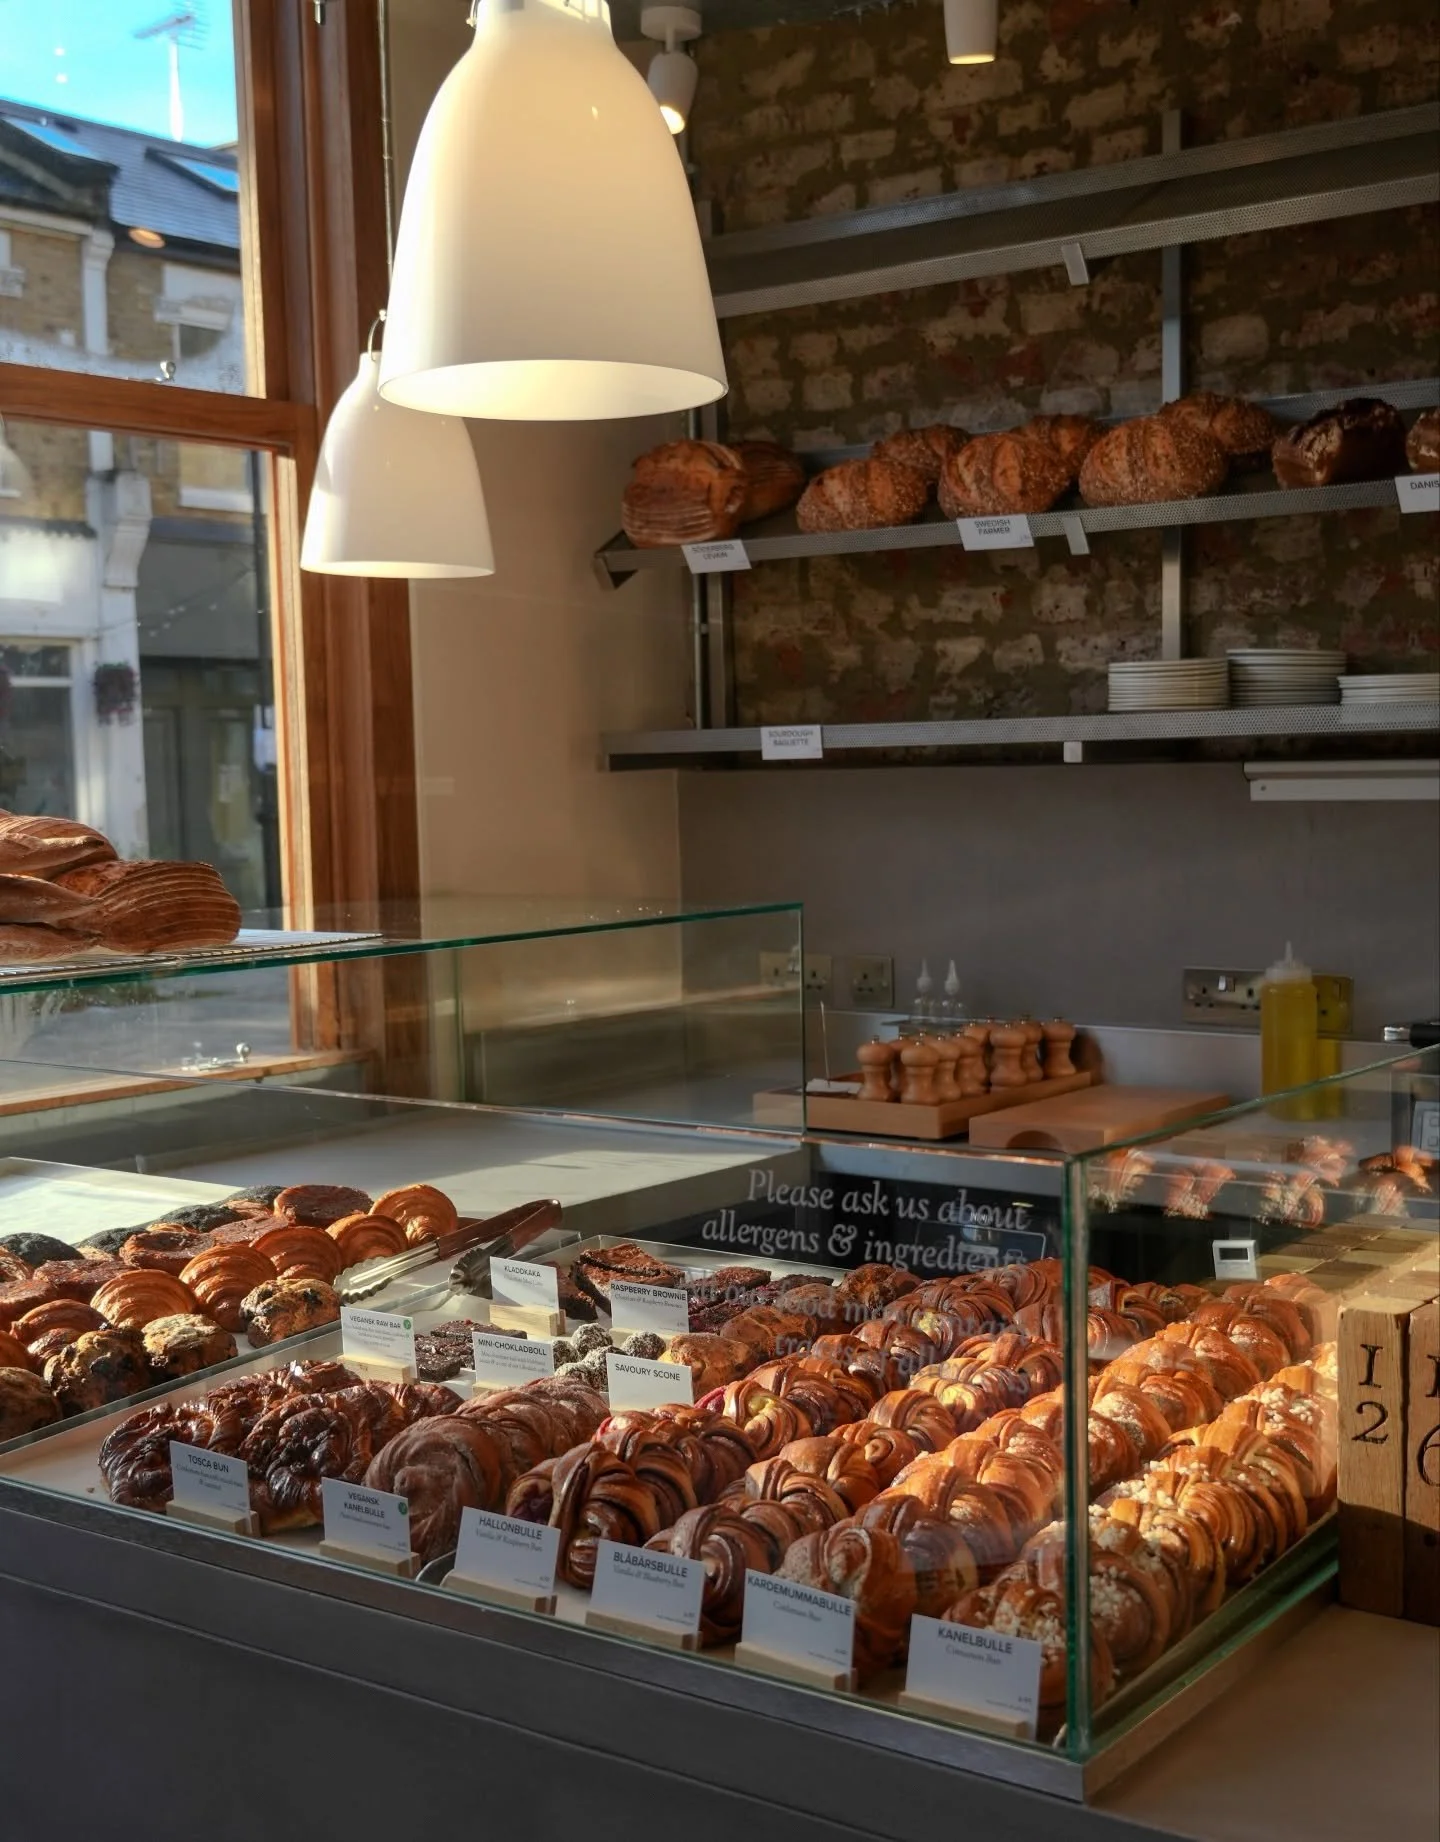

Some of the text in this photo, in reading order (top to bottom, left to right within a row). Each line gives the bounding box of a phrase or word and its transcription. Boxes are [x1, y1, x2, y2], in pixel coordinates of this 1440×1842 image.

[974, 519, 1011, 528] SWEDISH
[978, 527, 1011, 535] FARMER
[749, 1168, 1031, 1231] Please ask us about
[702, 1210, 820, 1255] allergens
[827, 1223, 858, 1257] &
[504, 1265, 542, 1277] KLADDKAKA
[611, 1283, 686, 1301] RASPBERRY BROWNIE
[349, 1315, 375, 1325] VEGANSK
[376, 1319, 389, 1327] RAW
[478, 1339, 548, 1356] MINI-CHOKLADBOLL
[615, 1363, 681, 1381] SAVOURY SCONE
[1351, 1401, 1389, 1444] 2
[188, 1454, 229, 1473] TOSCA BUN
[348, 1491, 380, 1505] VEGANSK
[344, 1501, 385, 1519] KANELBULLE
[479, 1516, 543, 1540] HALLONBULLE
[748, 1575, 852, 1616] KARDEMUMMABULLE
[938, 1626, 1014, 1655] KANELBULLE
